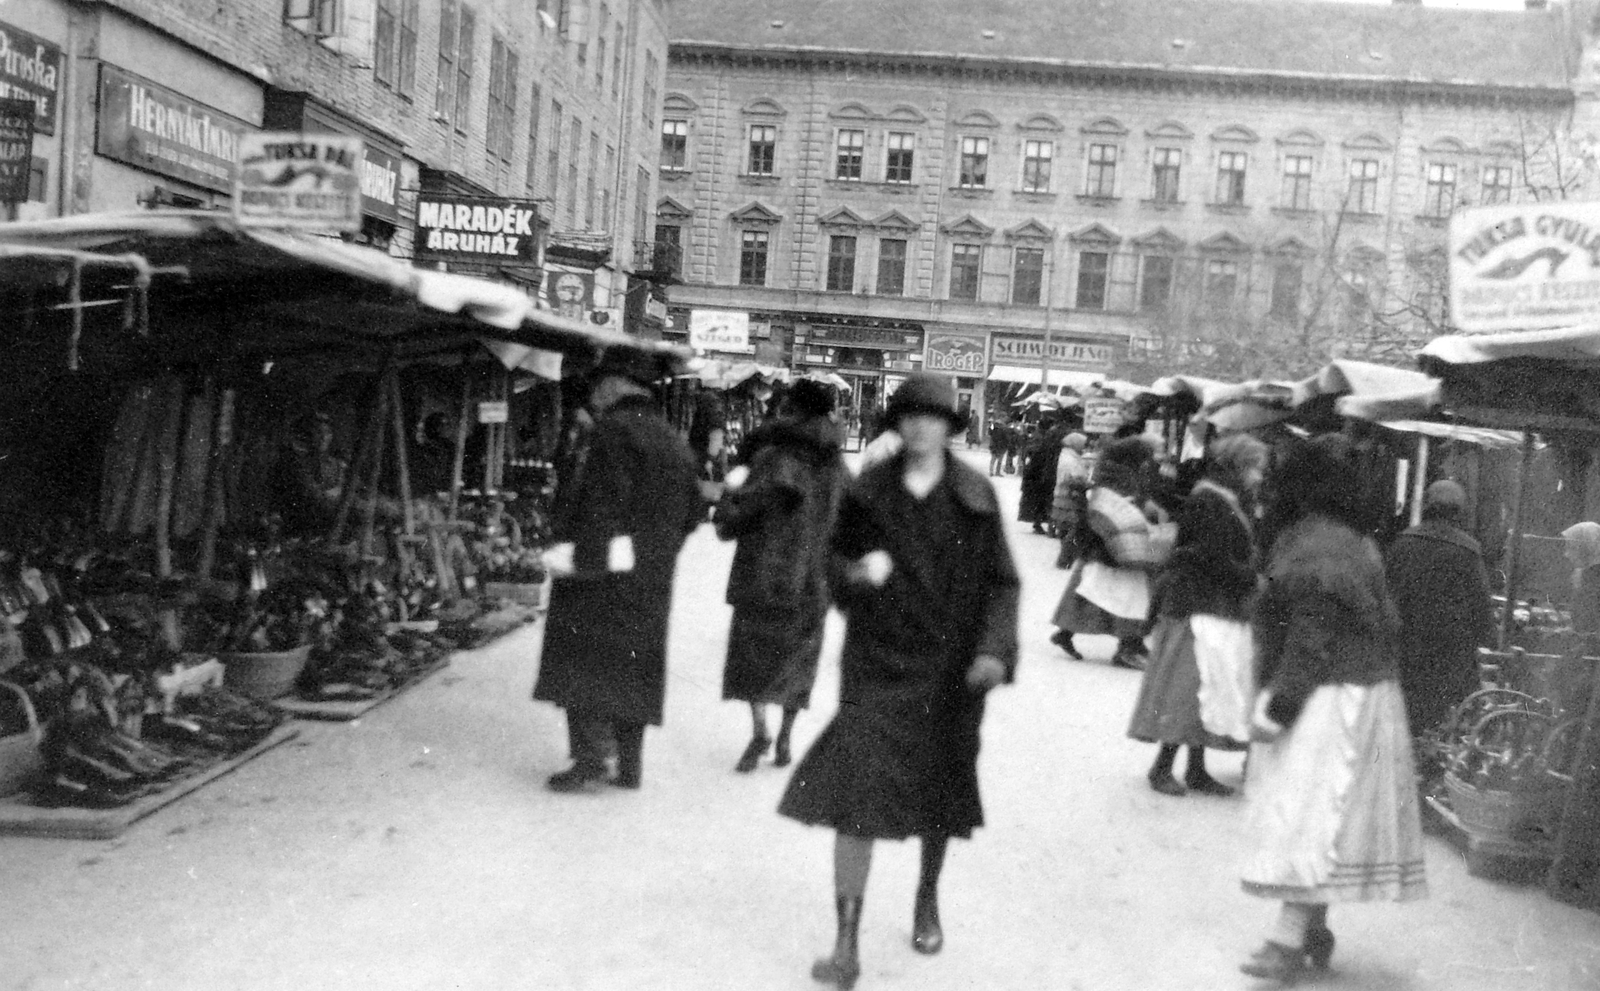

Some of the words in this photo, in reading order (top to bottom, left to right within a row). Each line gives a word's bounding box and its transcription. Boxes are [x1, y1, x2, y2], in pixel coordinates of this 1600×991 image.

[419, 202, 533, 236] MARADÉK
[427, 228, 519, 256] ÁRUHÁZ
[996, 340, 1067, 358] SCHMDT
